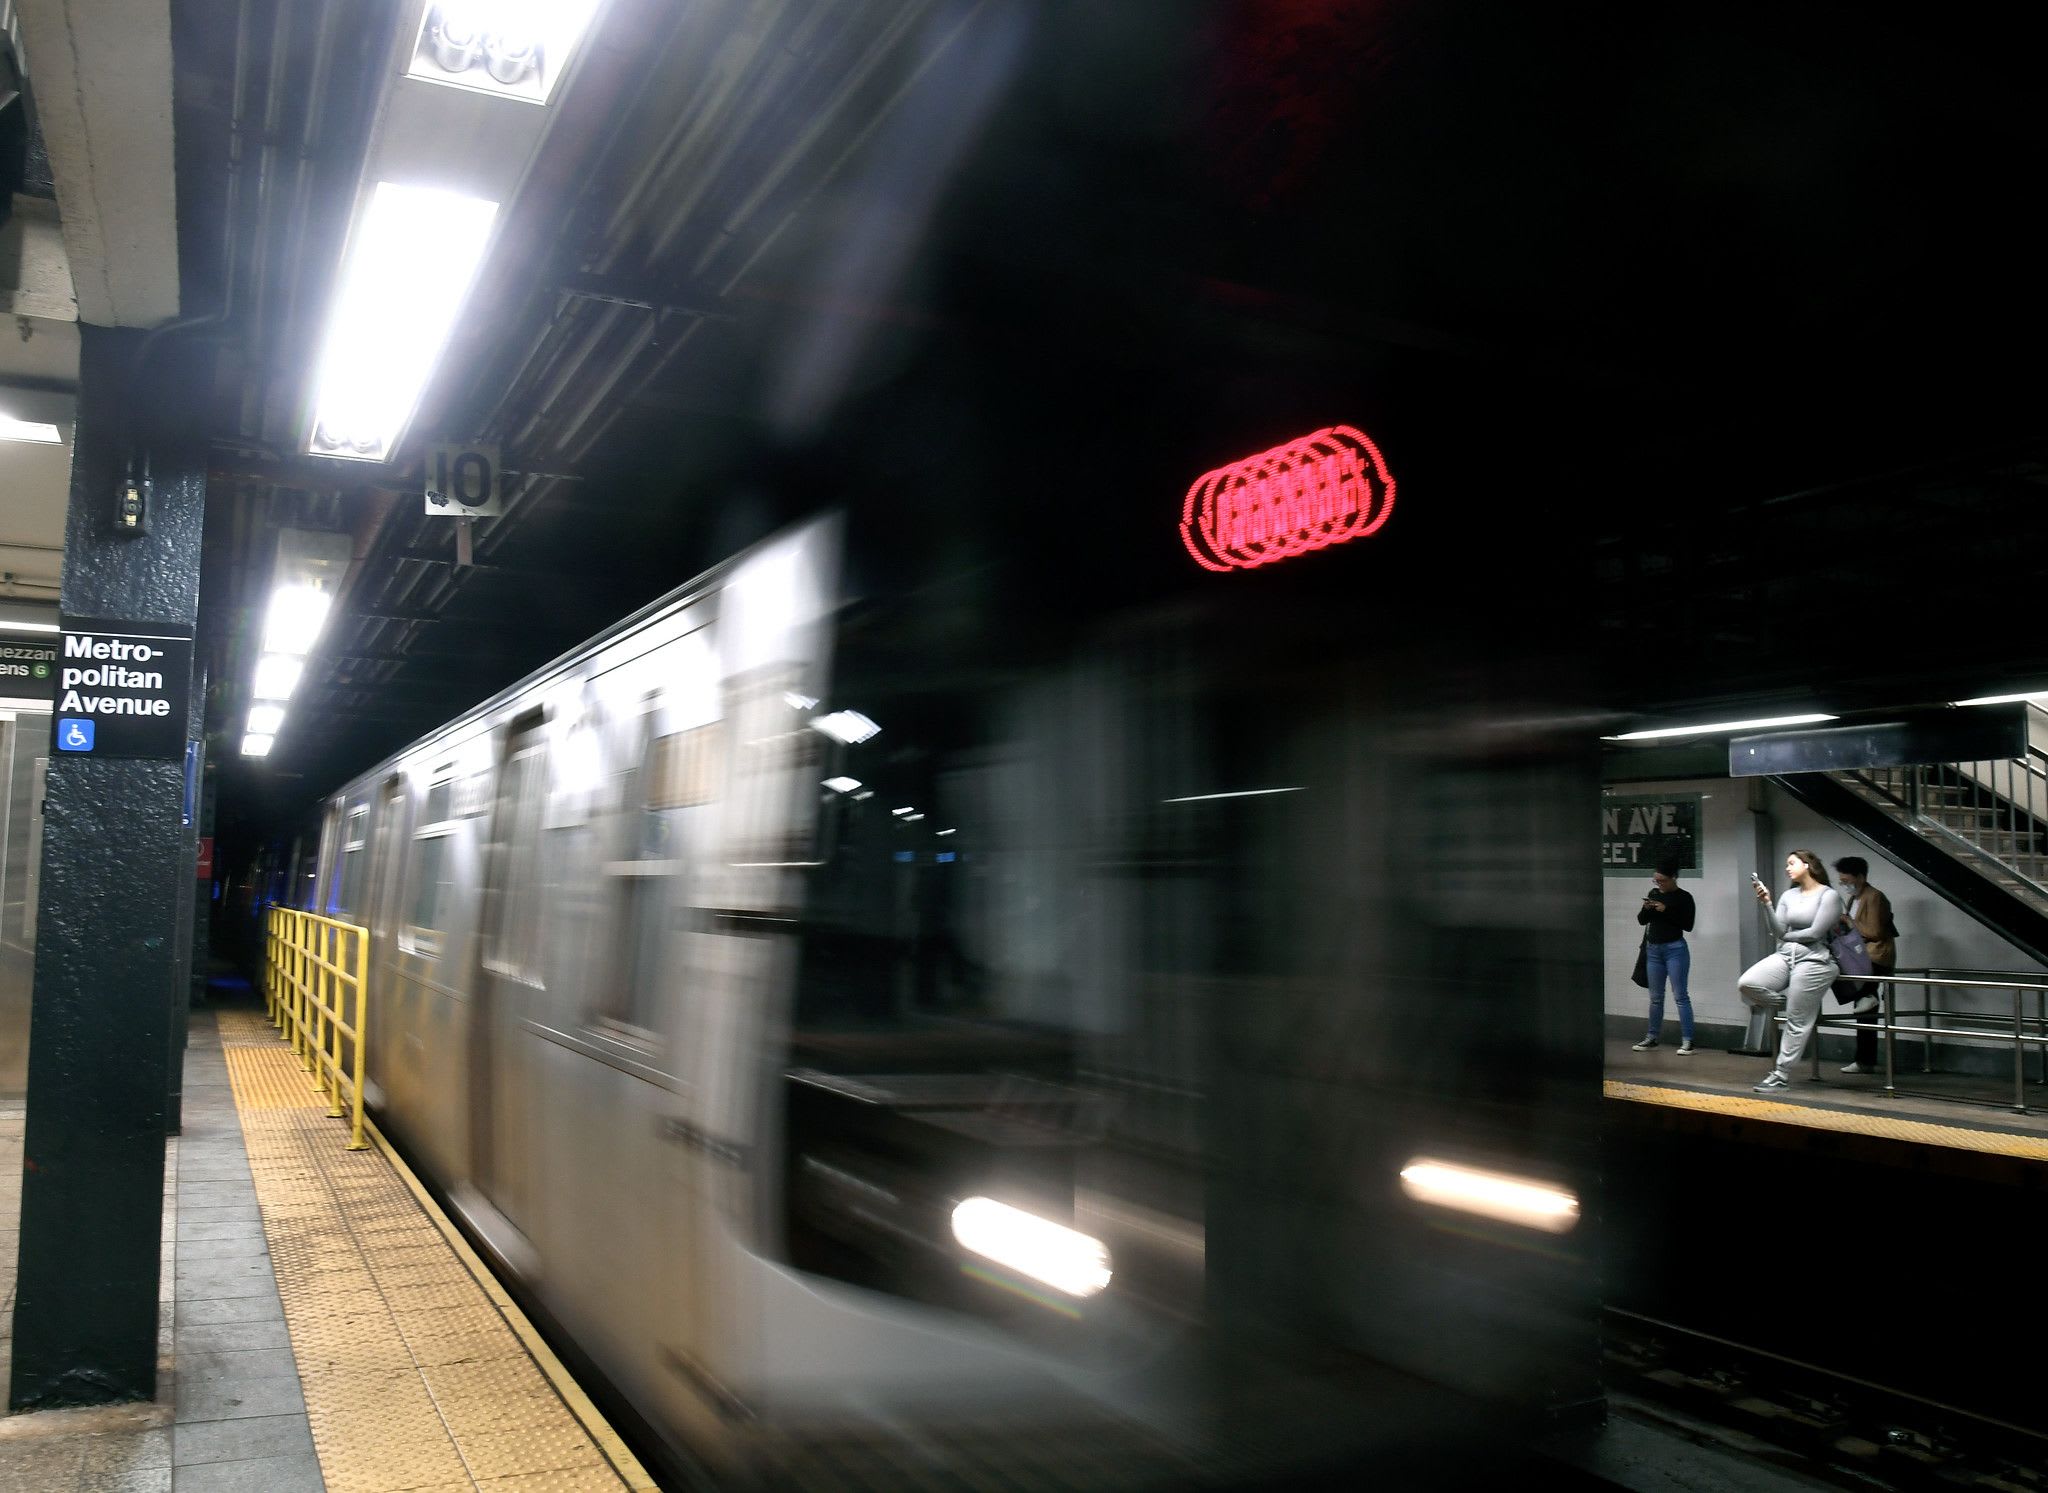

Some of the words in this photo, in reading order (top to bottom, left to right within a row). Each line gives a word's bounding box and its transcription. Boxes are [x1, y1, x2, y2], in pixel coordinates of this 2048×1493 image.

[436, 451, 491, 508] 10
[64, 635, 164, 662] Metro-
[62, 665, 163, 689] politan
[59, 690, 170, 716] Avenue
[1628, 805, 1687, 835] AVE.
